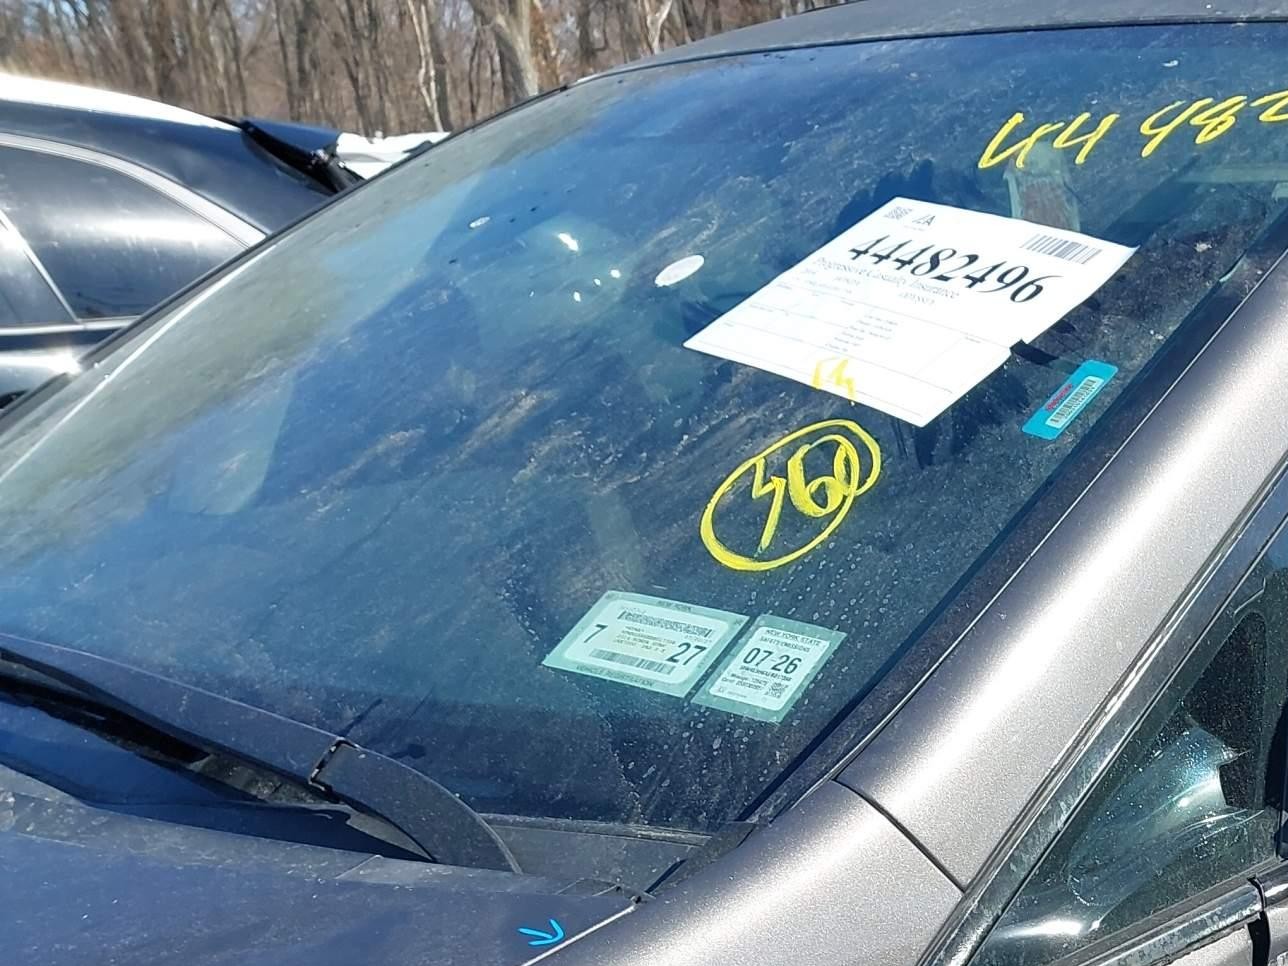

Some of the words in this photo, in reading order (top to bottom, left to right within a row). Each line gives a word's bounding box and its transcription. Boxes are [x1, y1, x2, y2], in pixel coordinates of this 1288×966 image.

[849, 234, 1064, 303] 44482496
[584, 624, 608, 643] 7
[666, 642, 708, 666] 27
[743, 647, 802, 674] 07-26
